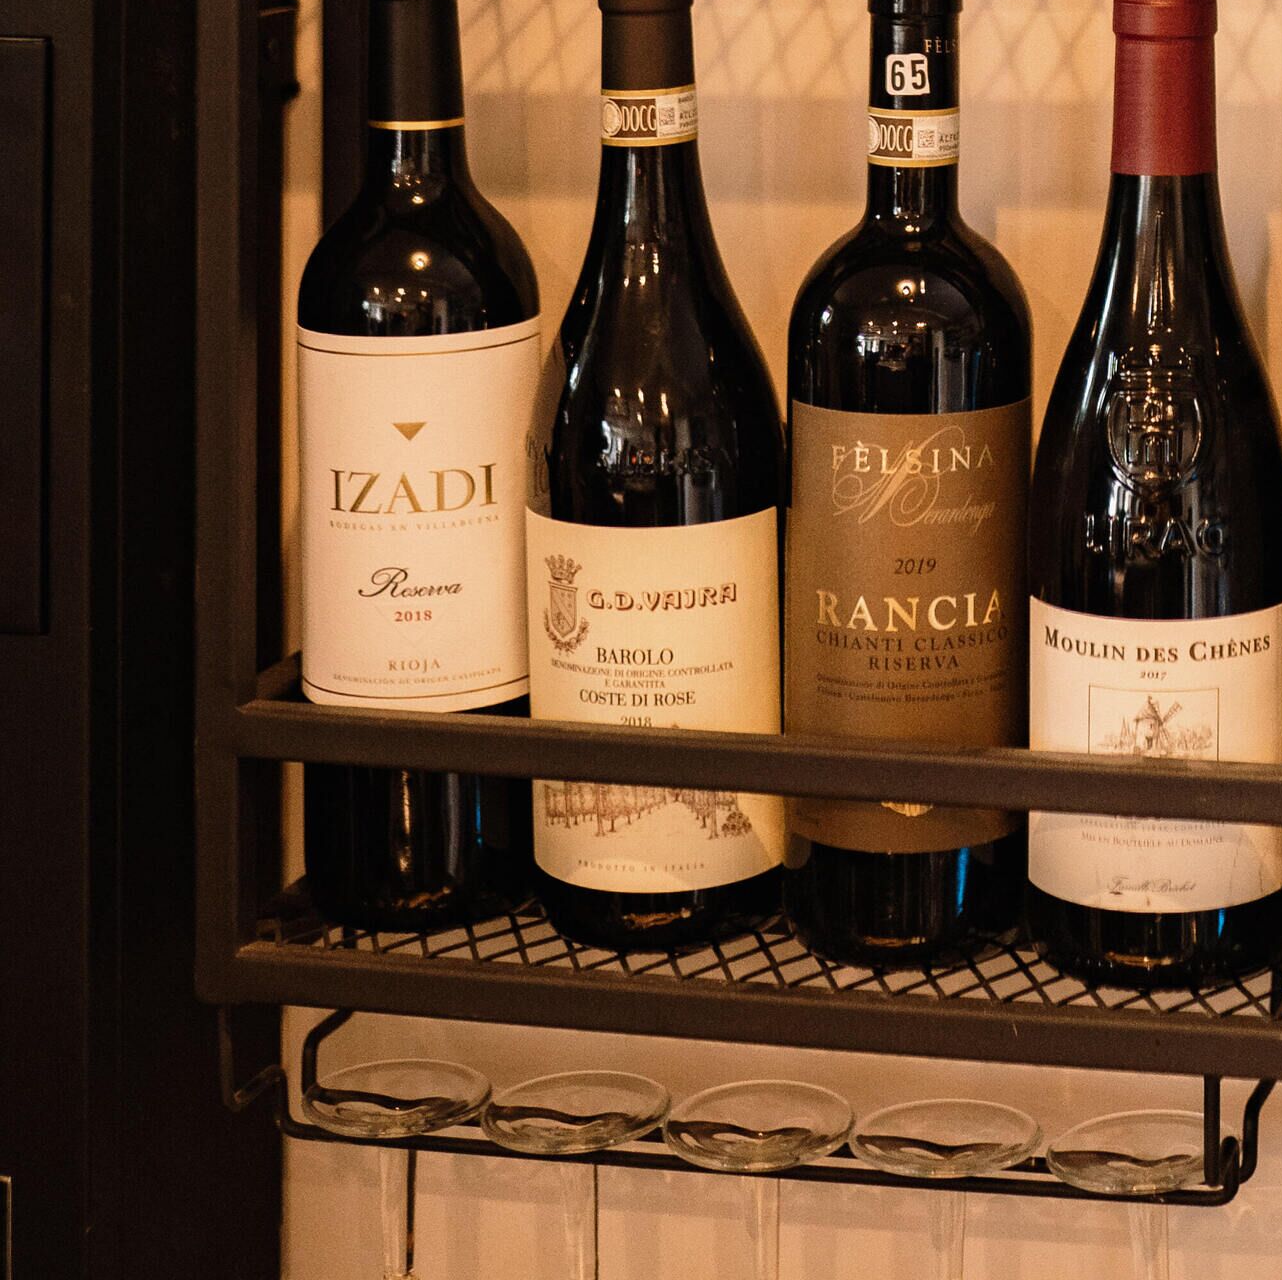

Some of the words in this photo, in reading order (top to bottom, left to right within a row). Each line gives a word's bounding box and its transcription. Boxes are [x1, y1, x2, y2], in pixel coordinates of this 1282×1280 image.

[890, 59, 927, 92] 65
[621, 103, 657, 133] DOCG
[879, 124, 914, 152] DOCG
[831, 441, 995, 475] FÈLSINA
[329, 462, 499, 515] IZADI
[329, 518, 383, 532] BODEGAS
[390, 523, 408, 531] EN
[894, 558, 937, 576] 2019
[358, 566, 463, 600] Reserva
[394, 609, 433, 623] 2018
[815, 588, 1006, 633] RANCIA
[815, 630, 903, 652] CHIANTI
[914, 625, 1008, 653] CLASSICO
[1044, 625, 1126, 661] MOULIN
[1136, 646, 1179, 663] DES
[1189, 635, 1271, 663] CHÊNES
[388, 659, 442, 673] RIOJA
[596, 647, 675, 667] BAROLO
[868, 654, 960, 671] RISERVA
[551, 658, 612, 678] DENOMINAZIONE
[614, 669, 625, 678] DI
[625, 669, 665, 679] ORIGINE
[668, 660, 734, 678] CONTROLLATA
[1140, 670, 1168, 680] 2017
[611, 680, 666, 690] GARANTITA
[580, 688, 628, 707] COSTE
[631, 691, 649, 708] DI
[654, 690, 697, 707] ROSE
